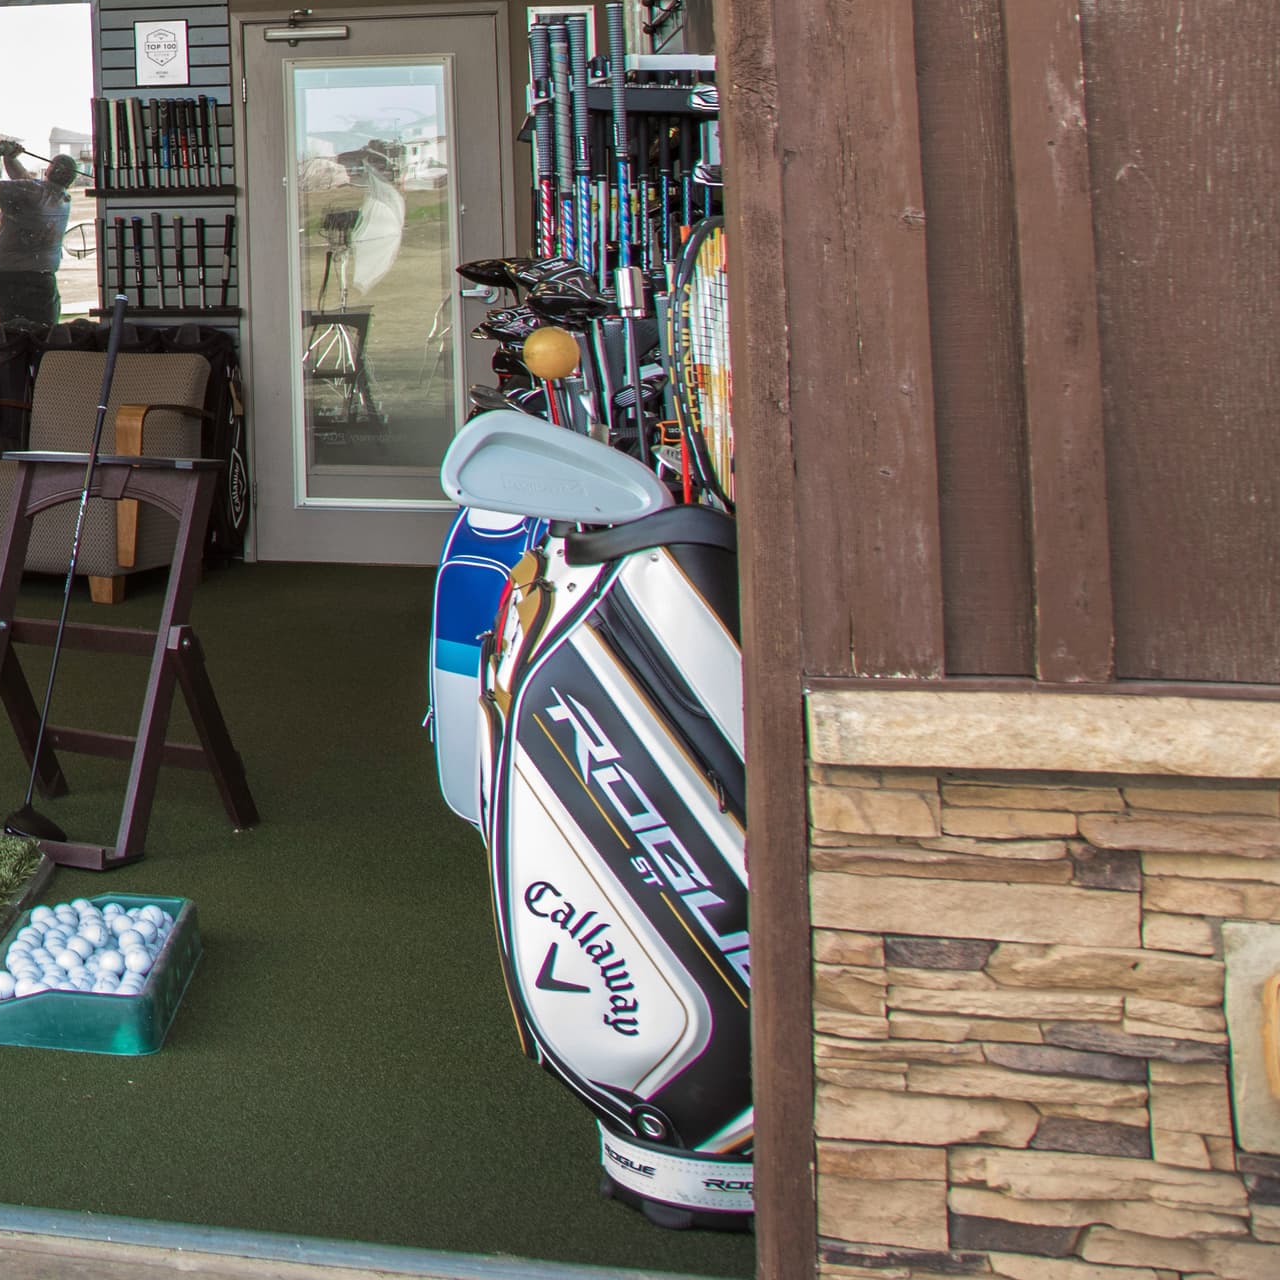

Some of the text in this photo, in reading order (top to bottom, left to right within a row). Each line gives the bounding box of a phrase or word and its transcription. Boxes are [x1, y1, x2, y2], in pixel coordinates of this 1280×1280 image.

[146, 42, 177, 51] TOP 100
[630, 855, 664, 887] ST
[524, 880, 640, 1037] Callaway
[604, 1142, 657, 1177] ROGUE
